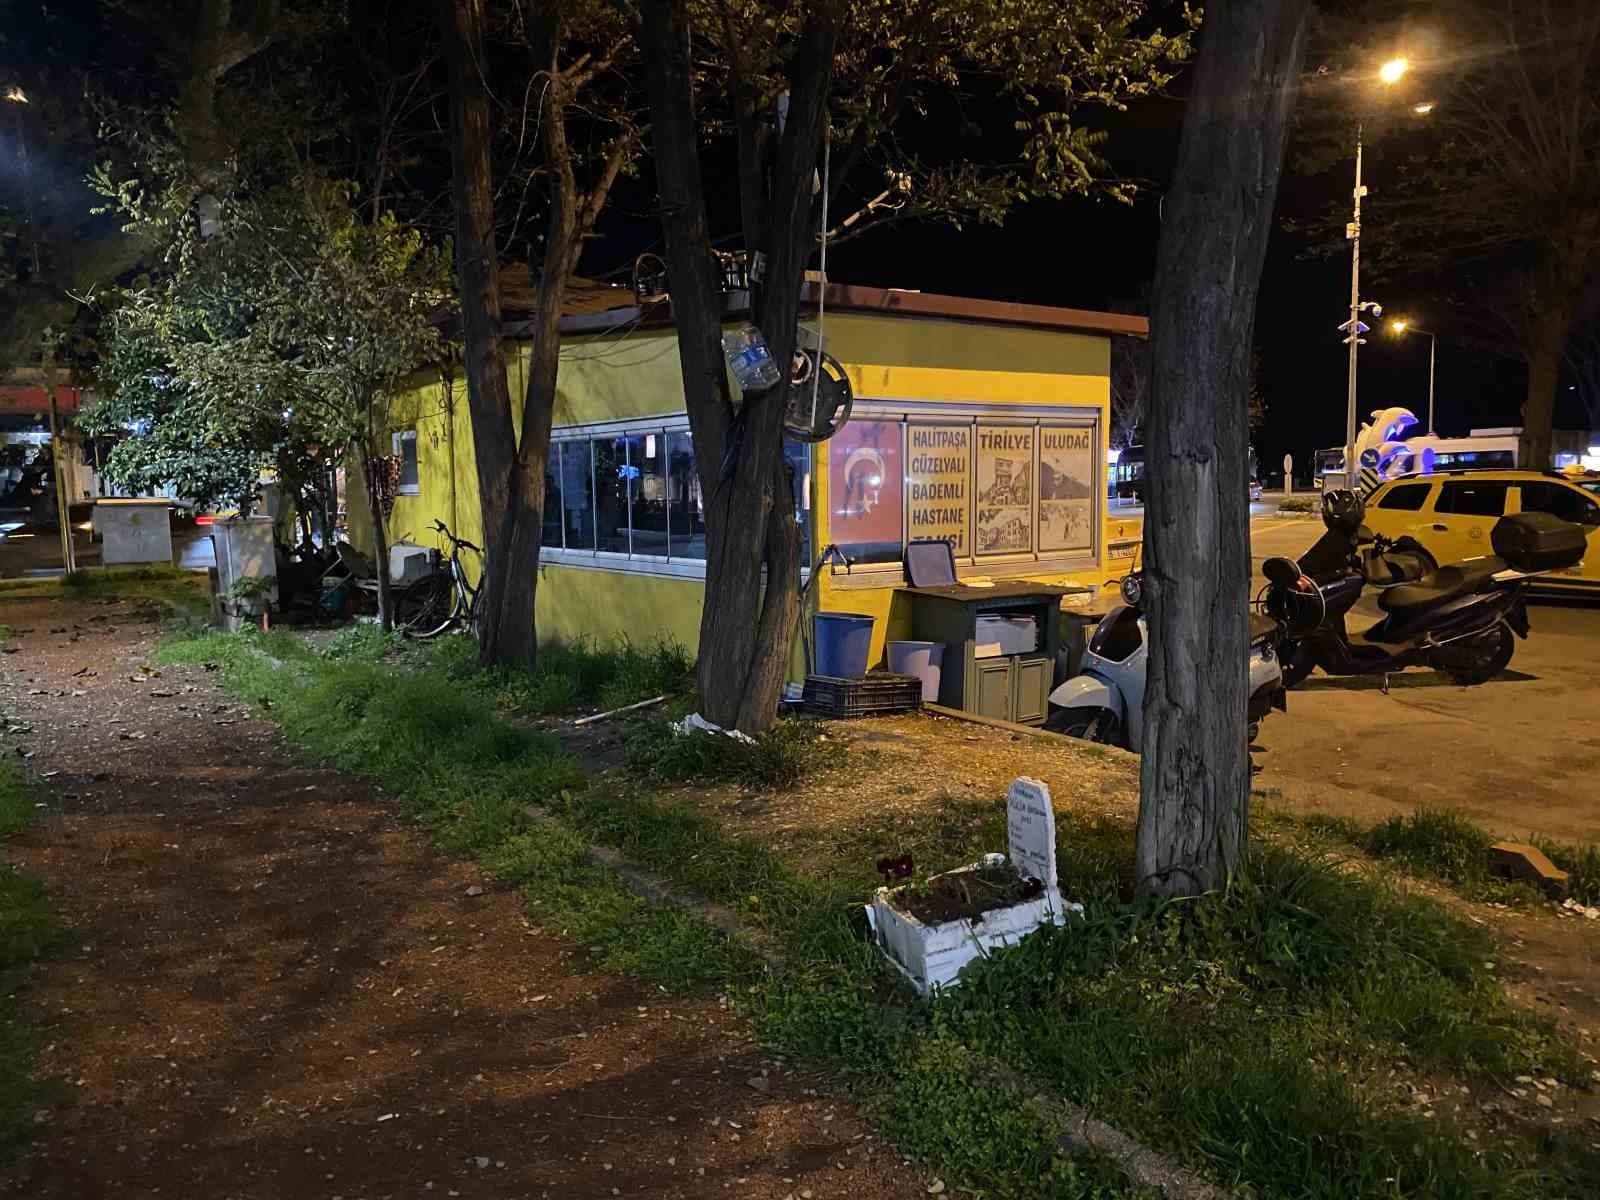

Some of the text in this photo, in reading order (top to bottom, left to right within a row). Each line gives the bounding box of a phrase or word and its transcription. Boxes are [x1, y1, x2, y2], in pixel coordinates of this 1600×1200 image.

[913, 427, 967, 453] HALİTPAŞA
[980, 429, 1031, 450] TİRİLYE
[1044, 431, 1089, 449] ULUDAĞ
[911, 453, 966, 473] GÜZELYALI
[912, 478, 964, 499] BADEMLİ
[912, 507, 964, 526] HASTANE
